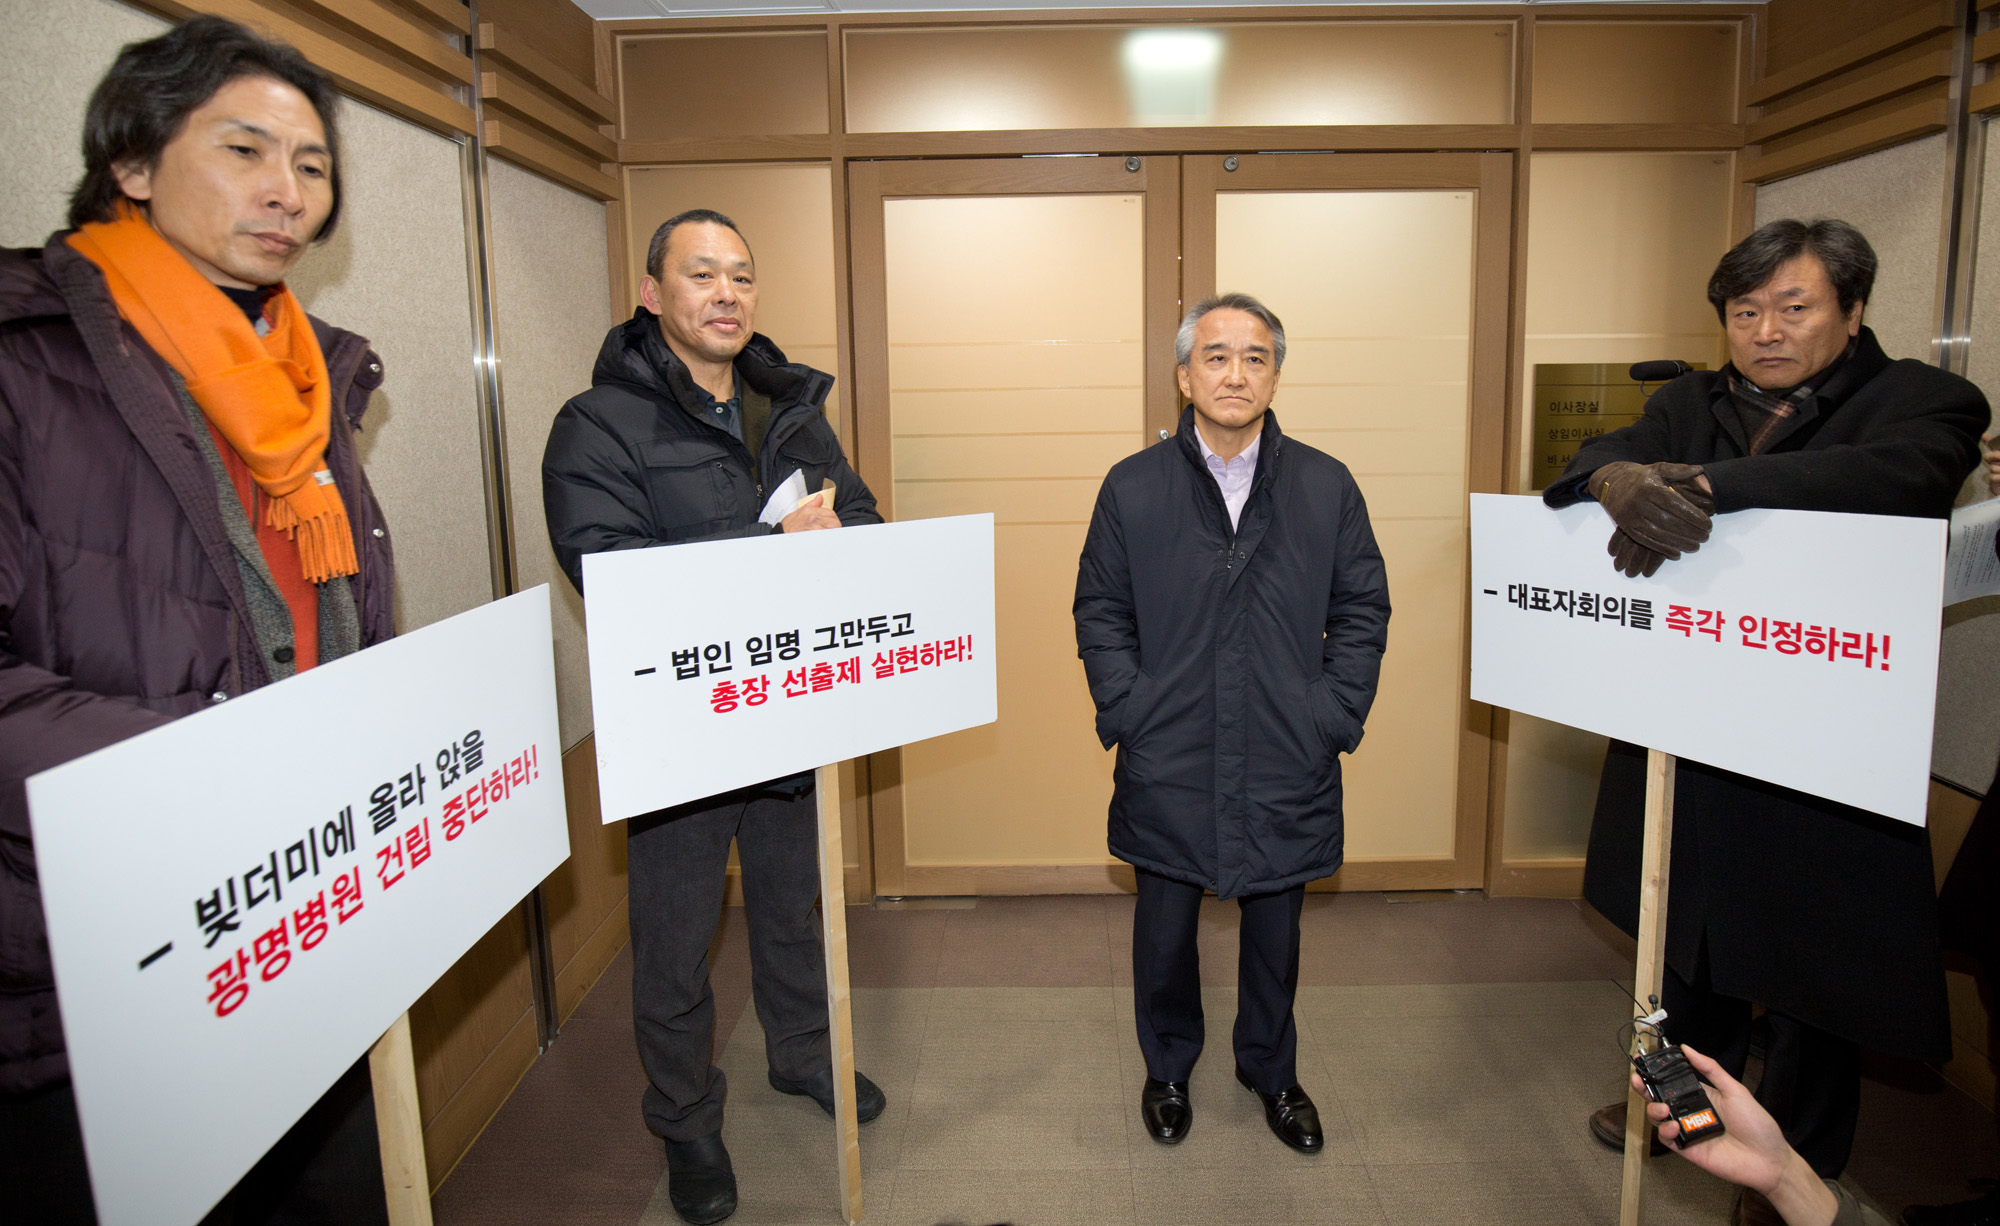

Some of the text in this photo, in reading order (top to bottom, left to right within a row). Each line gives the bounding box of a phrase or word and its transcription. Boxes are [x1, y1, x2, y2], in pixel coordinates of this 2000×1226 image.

[1549, 401, 1599, 413] 이사장실
[671, 640, 732, 681] 법인
[745, 629, 800, 667] 임명
[813, 612, 915, 652] 그만두고
[1508, 583, 1655, 631] 대표자회의를
[1665, 604, 1726, 643] 즉각
[1738, 615, 1892, 672] 인정하라!
[709, 634, 974, 714] 총장 선출제 실현하라!
[195, 804, 356, 949] 빚더미에
[368, 763, 426, 835] 올라
[436, 729, 485, 790] 앉을
[206, 743, 539, 1018] 광명병원 건립 중단하라!
[1684, 1112, 1713, 1130] MBN
